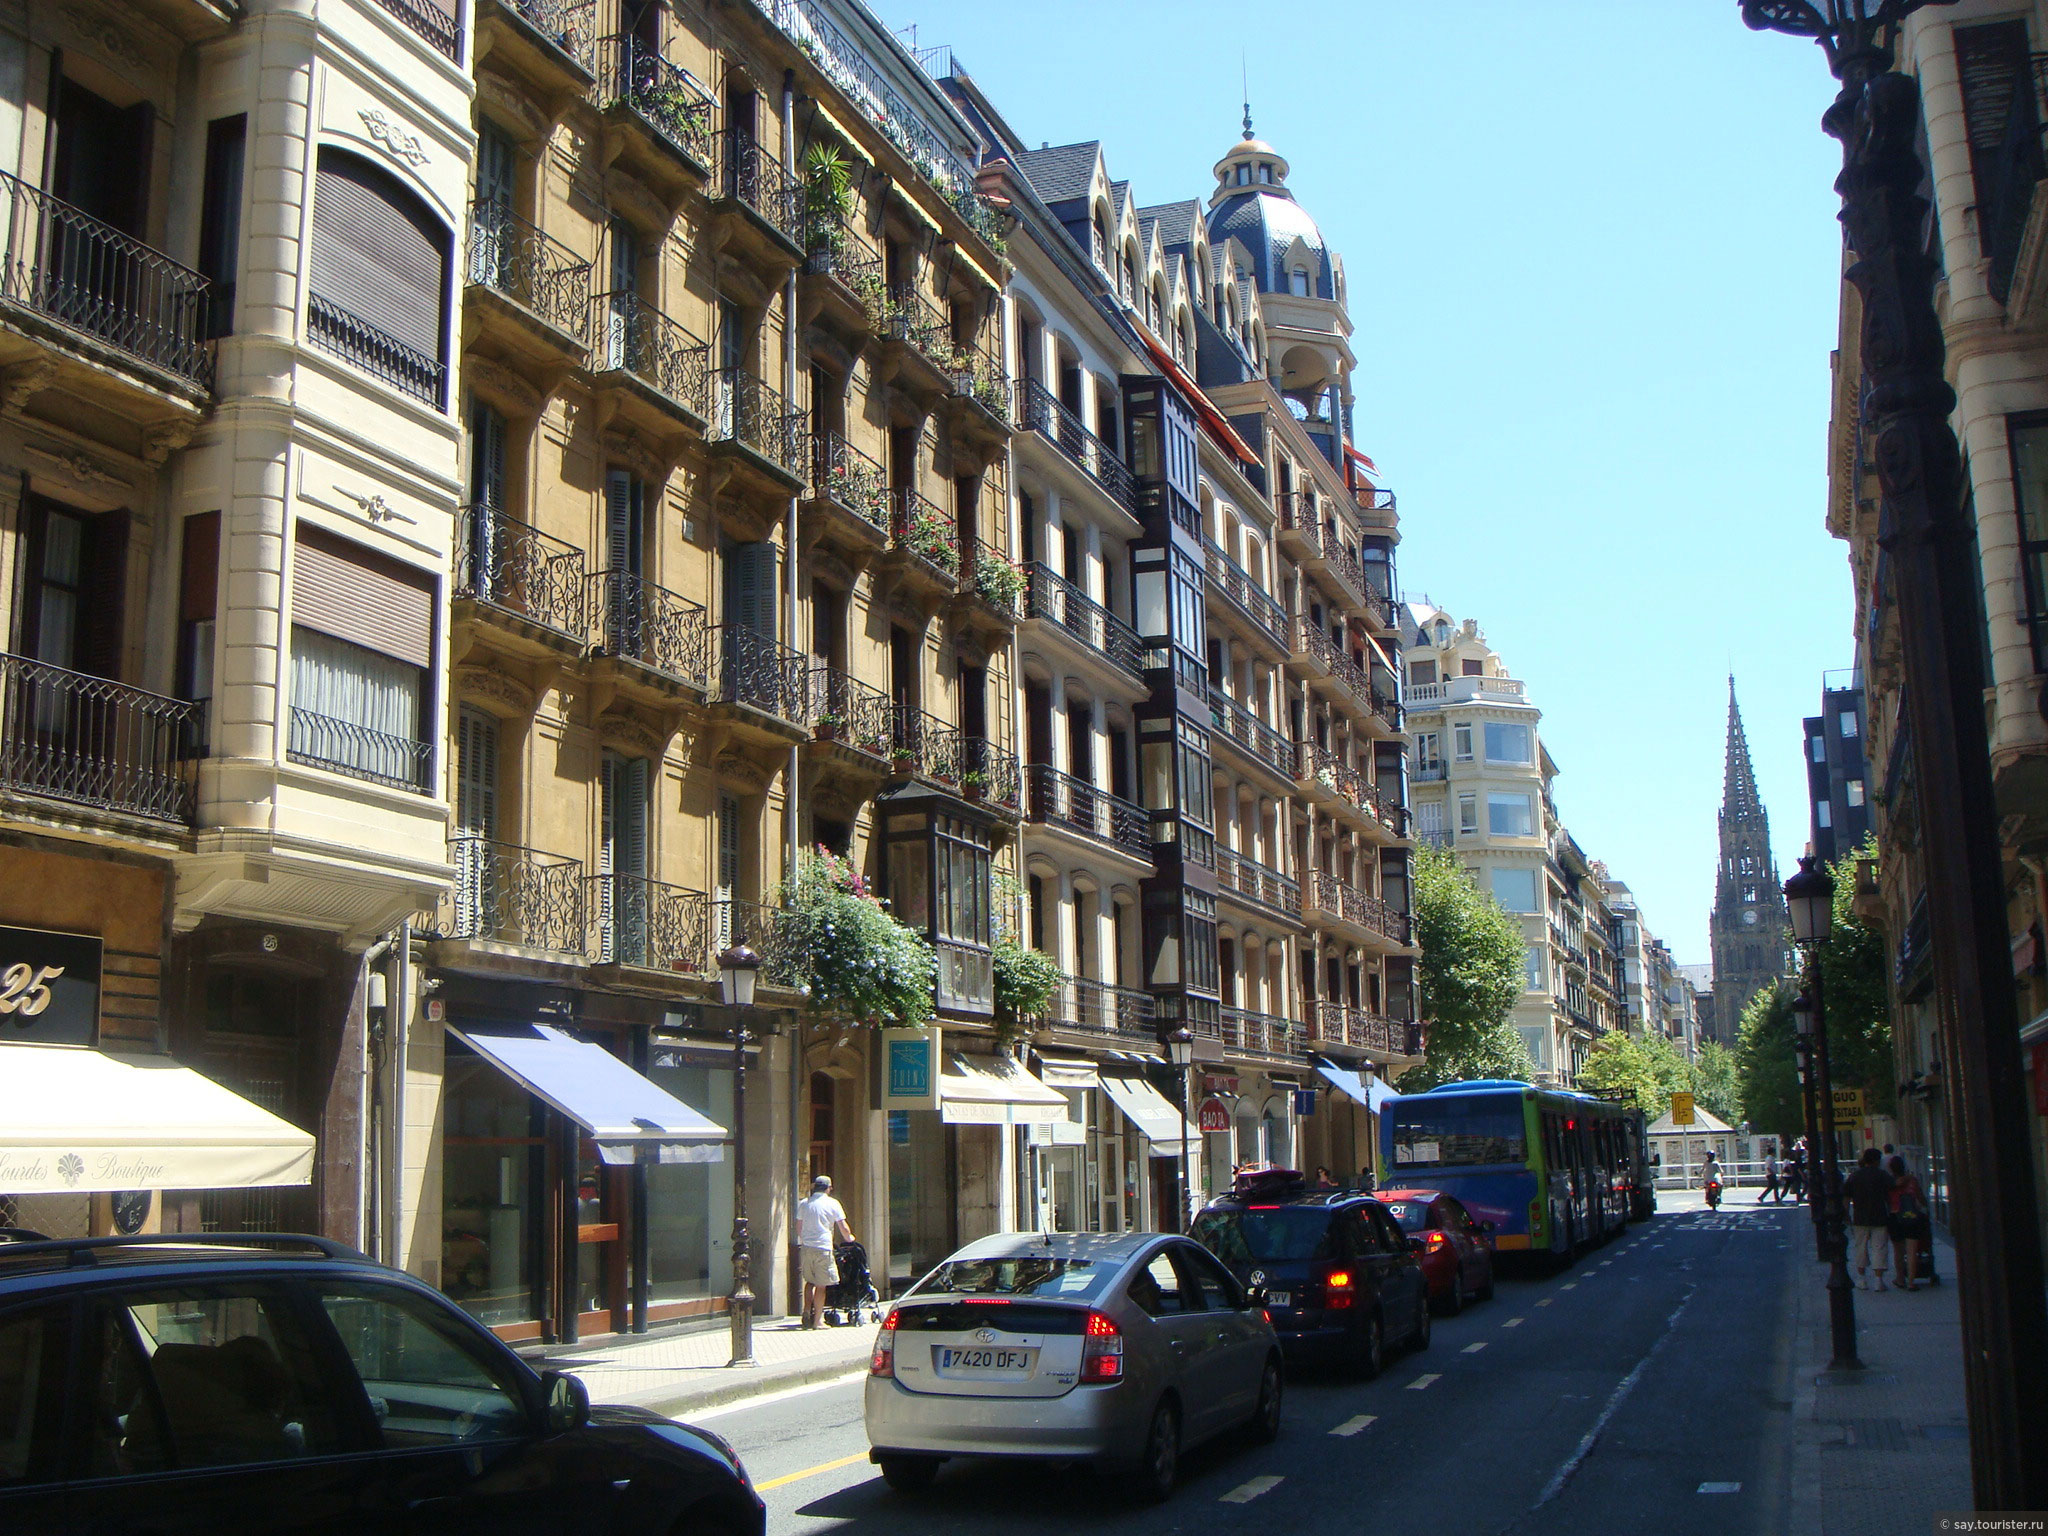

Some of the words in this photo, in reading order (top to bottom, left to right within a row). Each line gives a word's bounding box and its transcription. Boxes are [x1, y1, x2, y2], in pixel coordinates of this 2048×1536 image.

[264, 936, 277, 949] 25
[0, 963, 65, 1016] 25
[91, 1152, 164, 1187] Boutique
[953, 1351, 991, 1367] 7420
[996, 1352, 1028, 1369] DFJ
